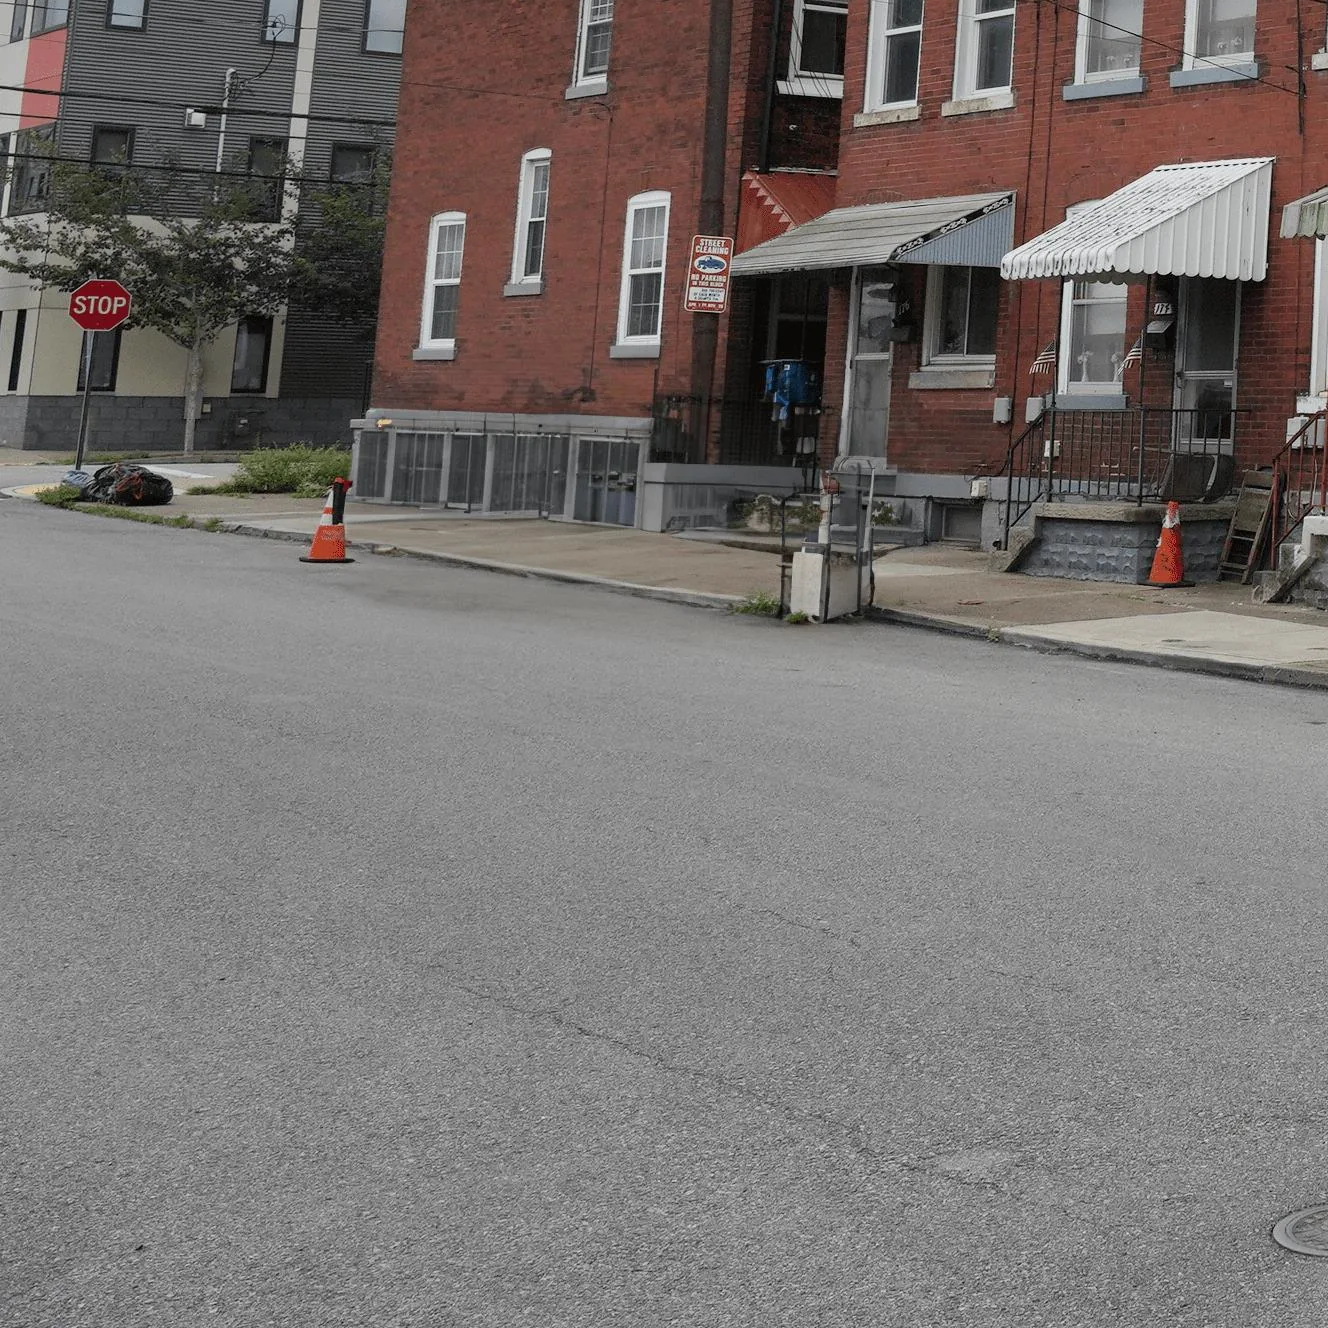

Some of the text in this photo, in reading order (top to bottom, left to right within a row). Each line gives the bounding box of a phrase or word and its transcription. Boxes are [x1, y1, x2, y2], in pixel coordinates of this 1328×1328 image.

[700, 239, 725, 247] STREET
[696, 246, 729, 255] CLEANING
[701, 274, 727, 283] PARKING
[73, 295, 127, 315] STOP
